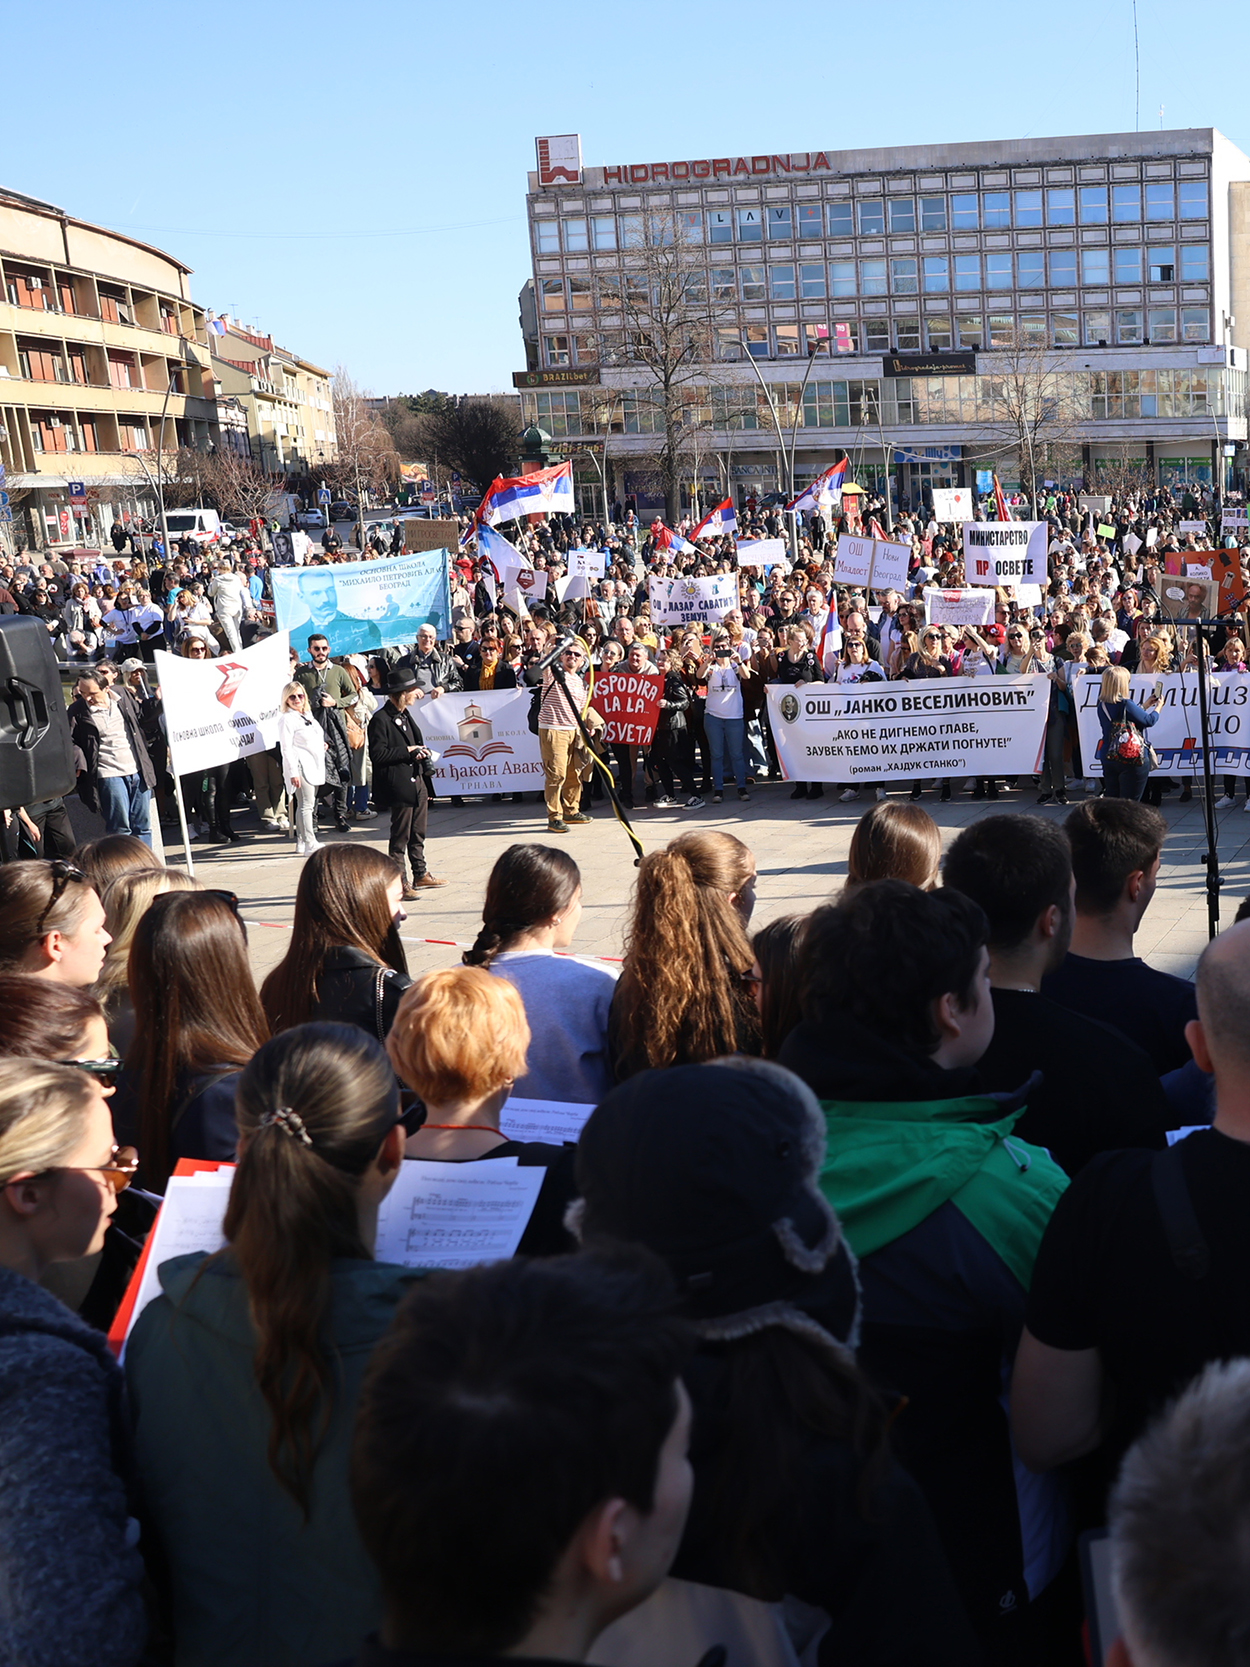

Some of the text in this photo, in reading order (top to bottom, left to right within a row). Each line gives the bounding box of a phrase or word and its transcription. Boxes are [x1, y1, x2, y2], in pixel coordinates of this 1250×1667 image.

[603, 151, 832, 185] HIDROGRADNJA
[731, 465, 758, 475] BANCA
[969, 529, 1028, 546] МИНИСТАРСТВО
[848, 541, 864, 556] ОШ
[882, 548, 900, 562] Нови
[359, 560, 426, 576] ОСНОВНА ШКОЛА
[873, 565, 902, 583] Београд
[995, 558, 1034, 575] ОСВЕТЕ
[382, 570, 423, 582] ПЕТРОВИЋ
[378, 580, 411, 591] БЕОГРАД
[680, 612, 708, 622] ЗЕМУН
[593, 675, 659, 702] KSPODIRA
[805, 690, 1035, 717] ОШ „ЈАНКО ВЕСЕЛИНОВИЋ”
[425, 729, 527, 741] ОСНОВНА ШКОЛА
[832, 722, 980, 742] „АКО НЕ ДИГНЕМО ГЛАВЕ,
[806, 736, 1012, 757] ЗАУВЕК ЋЕМО ИХ ДРЖАТИ ПОГНУТЕ!”
[450, 763, 497, 782] ђакон
[502, 762, 546, 778] Аваку
[849, 763, 882, 776] (роман
[460, 782, 503, 790] ТРНАВА
